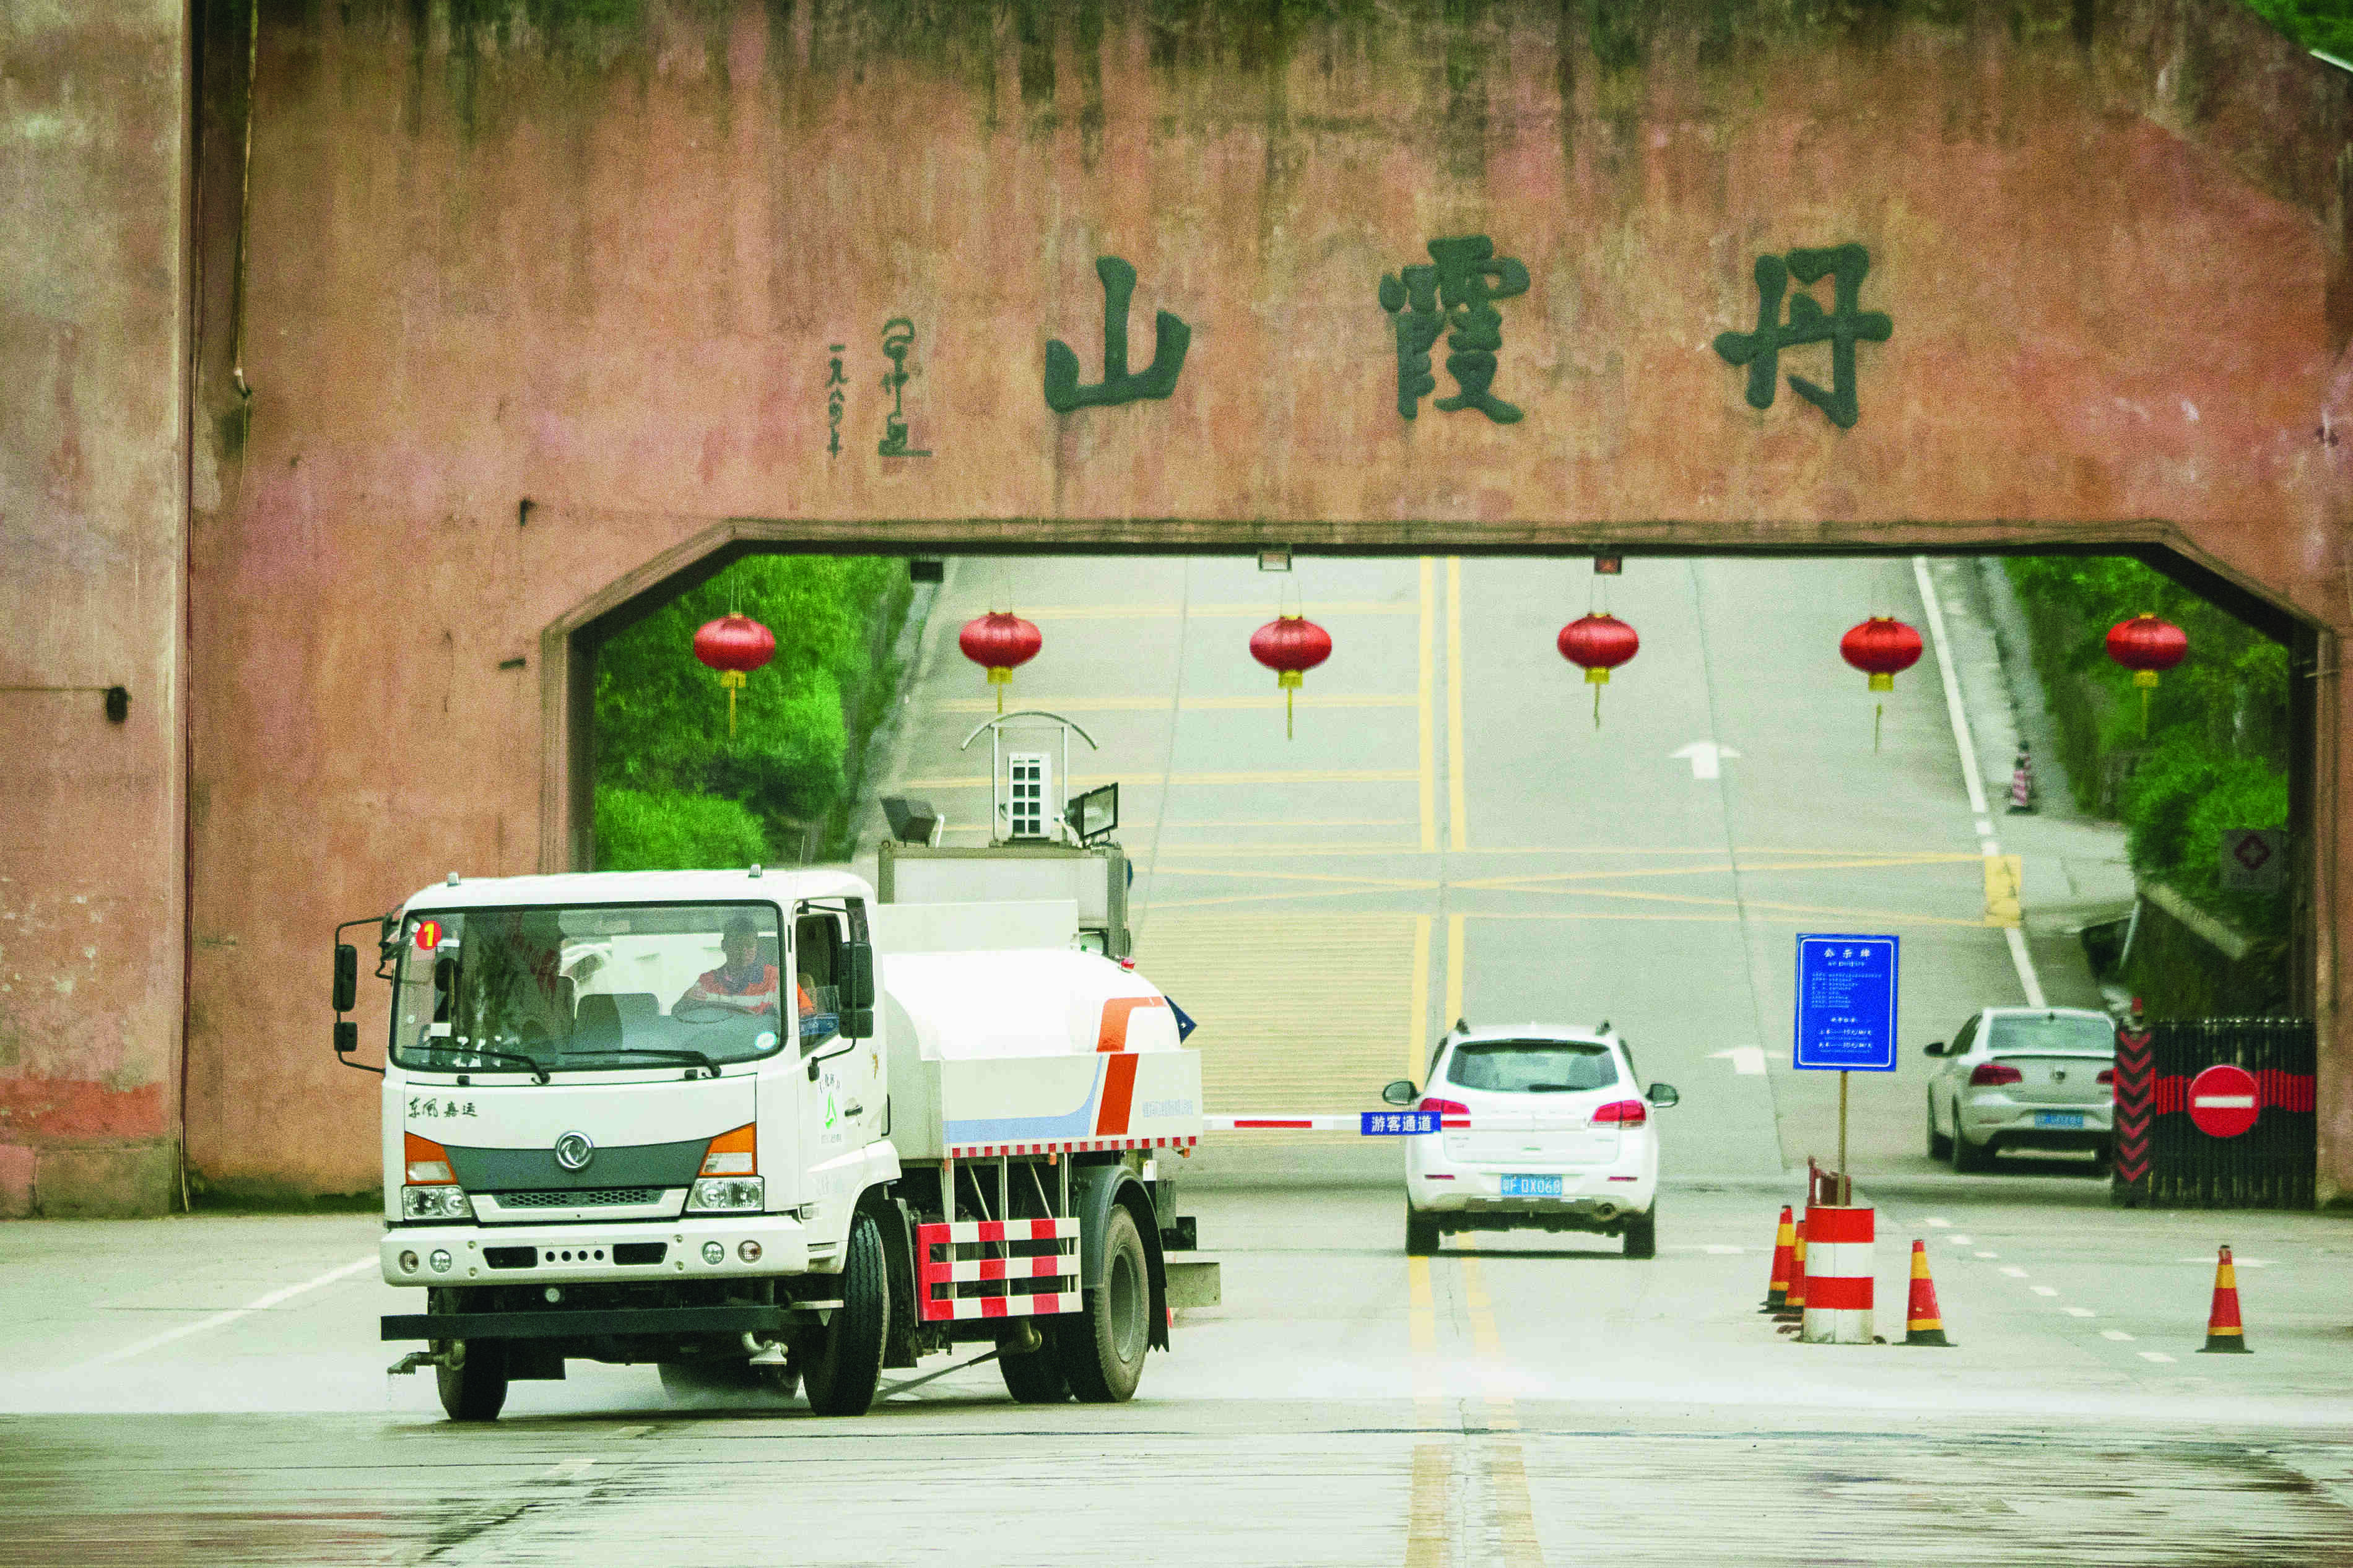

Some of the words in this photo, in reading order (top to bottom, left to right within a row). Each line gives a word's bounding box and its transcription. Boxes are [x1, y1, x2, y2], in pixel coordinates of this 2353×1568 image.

[424, 923, 435, 946] 1
[1372, 1115, 1432, 1132] 游客通道
